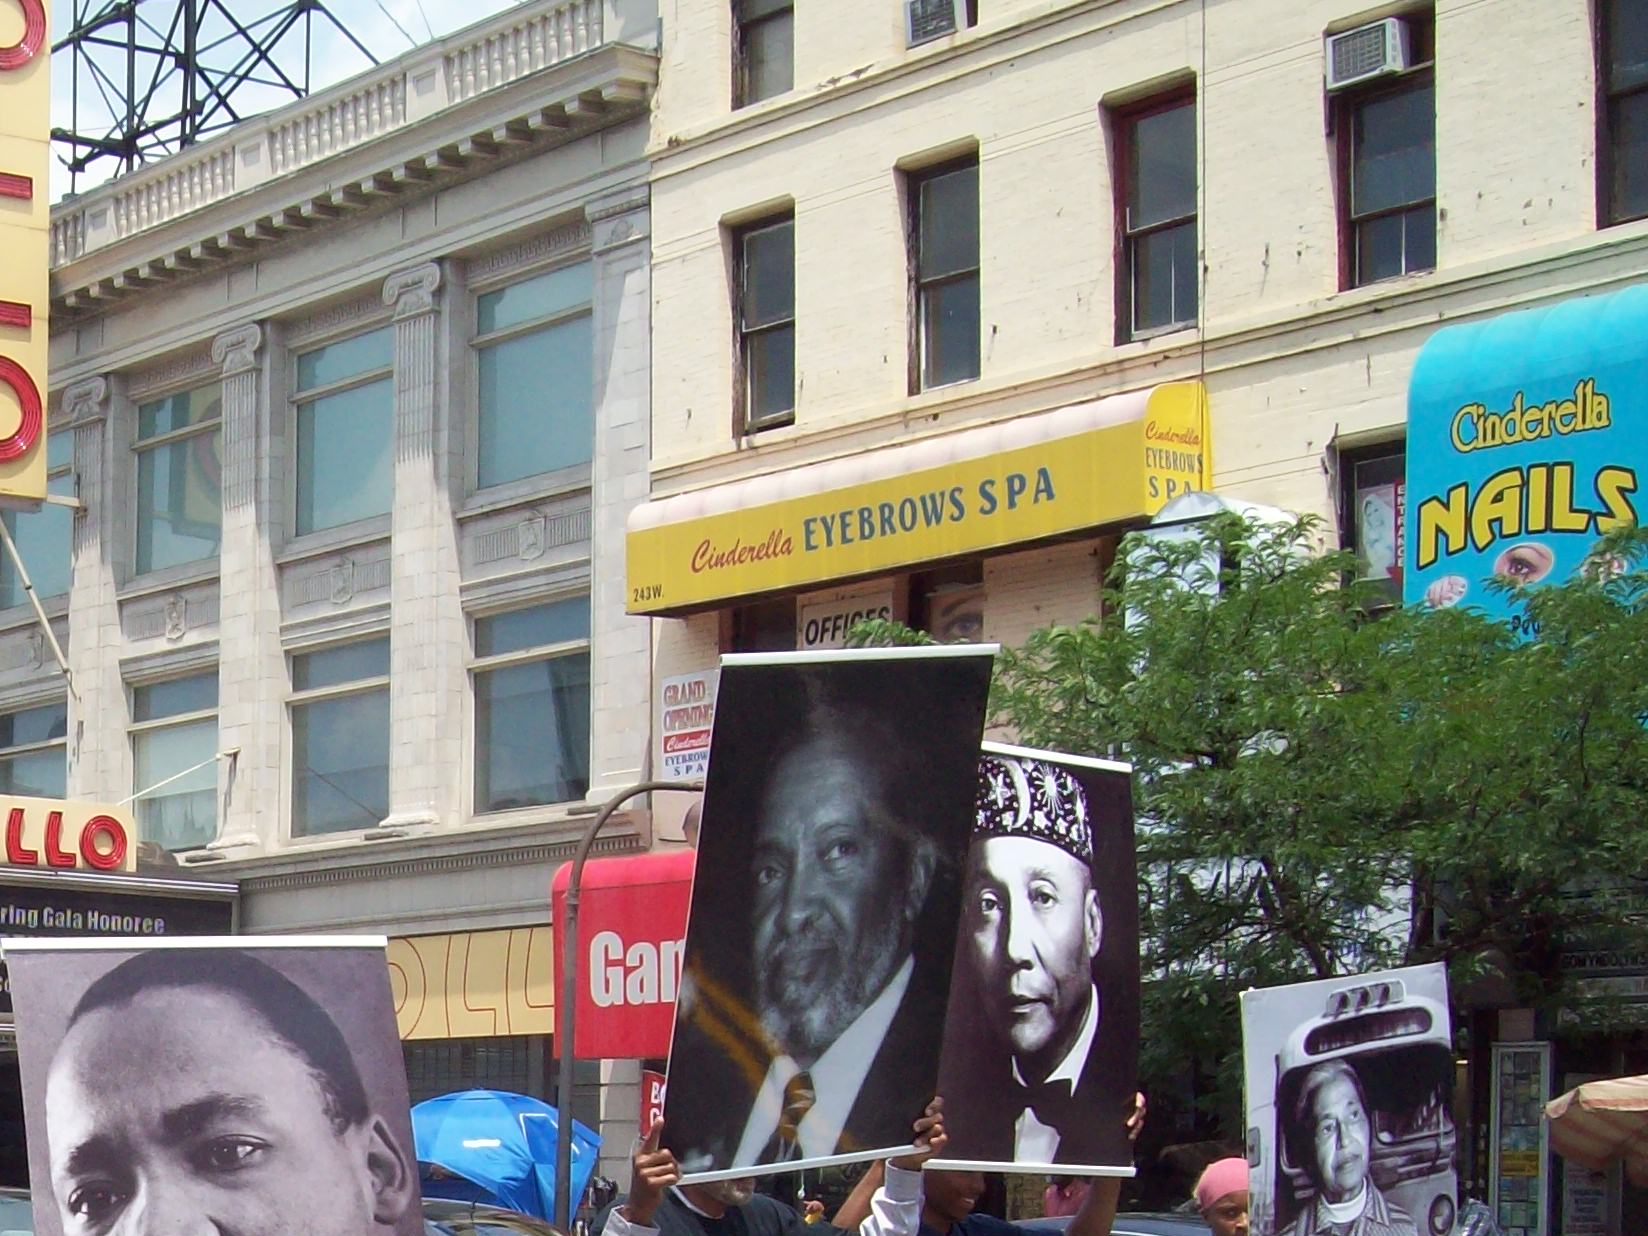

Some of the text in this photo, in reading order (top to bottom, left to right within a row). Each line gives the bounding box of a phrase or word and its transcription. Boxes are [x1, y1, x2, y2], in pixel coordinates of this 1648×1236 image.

[1451, 377, 1610, 453] Cinderella
[1145, 446, 1204, 475] EYEBROWS
[1149, 475, 1193, 500] SPA
[690, 467, 1056, 575] Cinderella EYEBROWS SPA
[1416, 461, 1638, 571] NAILS
[664, 681, 706, 707] GRAND
[673, 764, 705, 777] SPA
[42, 906, 83, 930] Gala
[87, 910, 166, 935] Honoree
